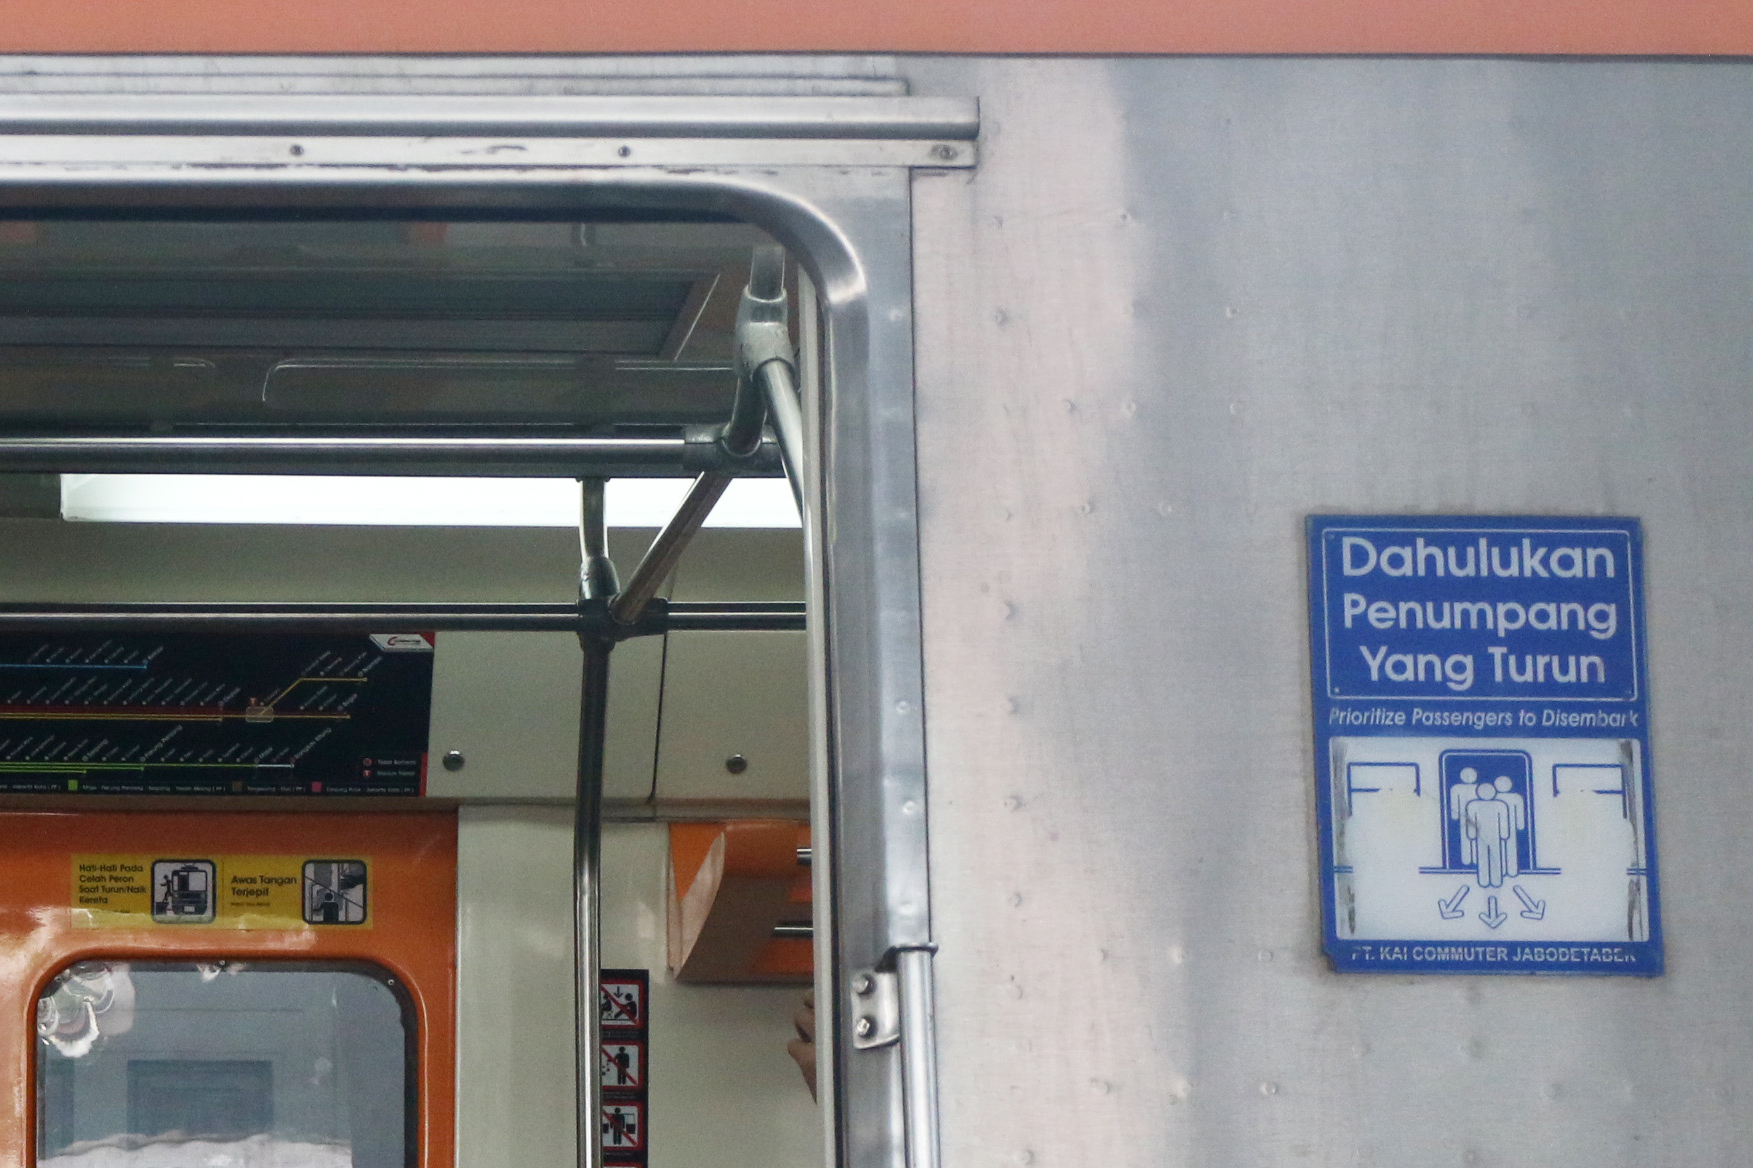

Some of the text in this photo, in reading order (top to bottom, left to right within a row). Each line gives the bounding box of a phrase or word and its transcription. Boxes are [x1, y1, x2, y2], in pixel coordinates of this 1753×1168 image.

[1342, 537, 1615, 578] Dahulukan
[1344, 593, 1617, 639] Penumpang
[1359, 646, 1605, 690] Yang Turun
[1329, 708, 1638, 729] Prioritize Passengers to Disembark
[120, 864, 144, 872] Pada
[109, 875, 134, 883] Peron
[231, 875, 297, 886] Awas Tangan
[231, 887, 269, 898] Terjepit
[1380, 946, 1408, 960] KAI
[1413, 946, 1508, 961] COMMUTER
